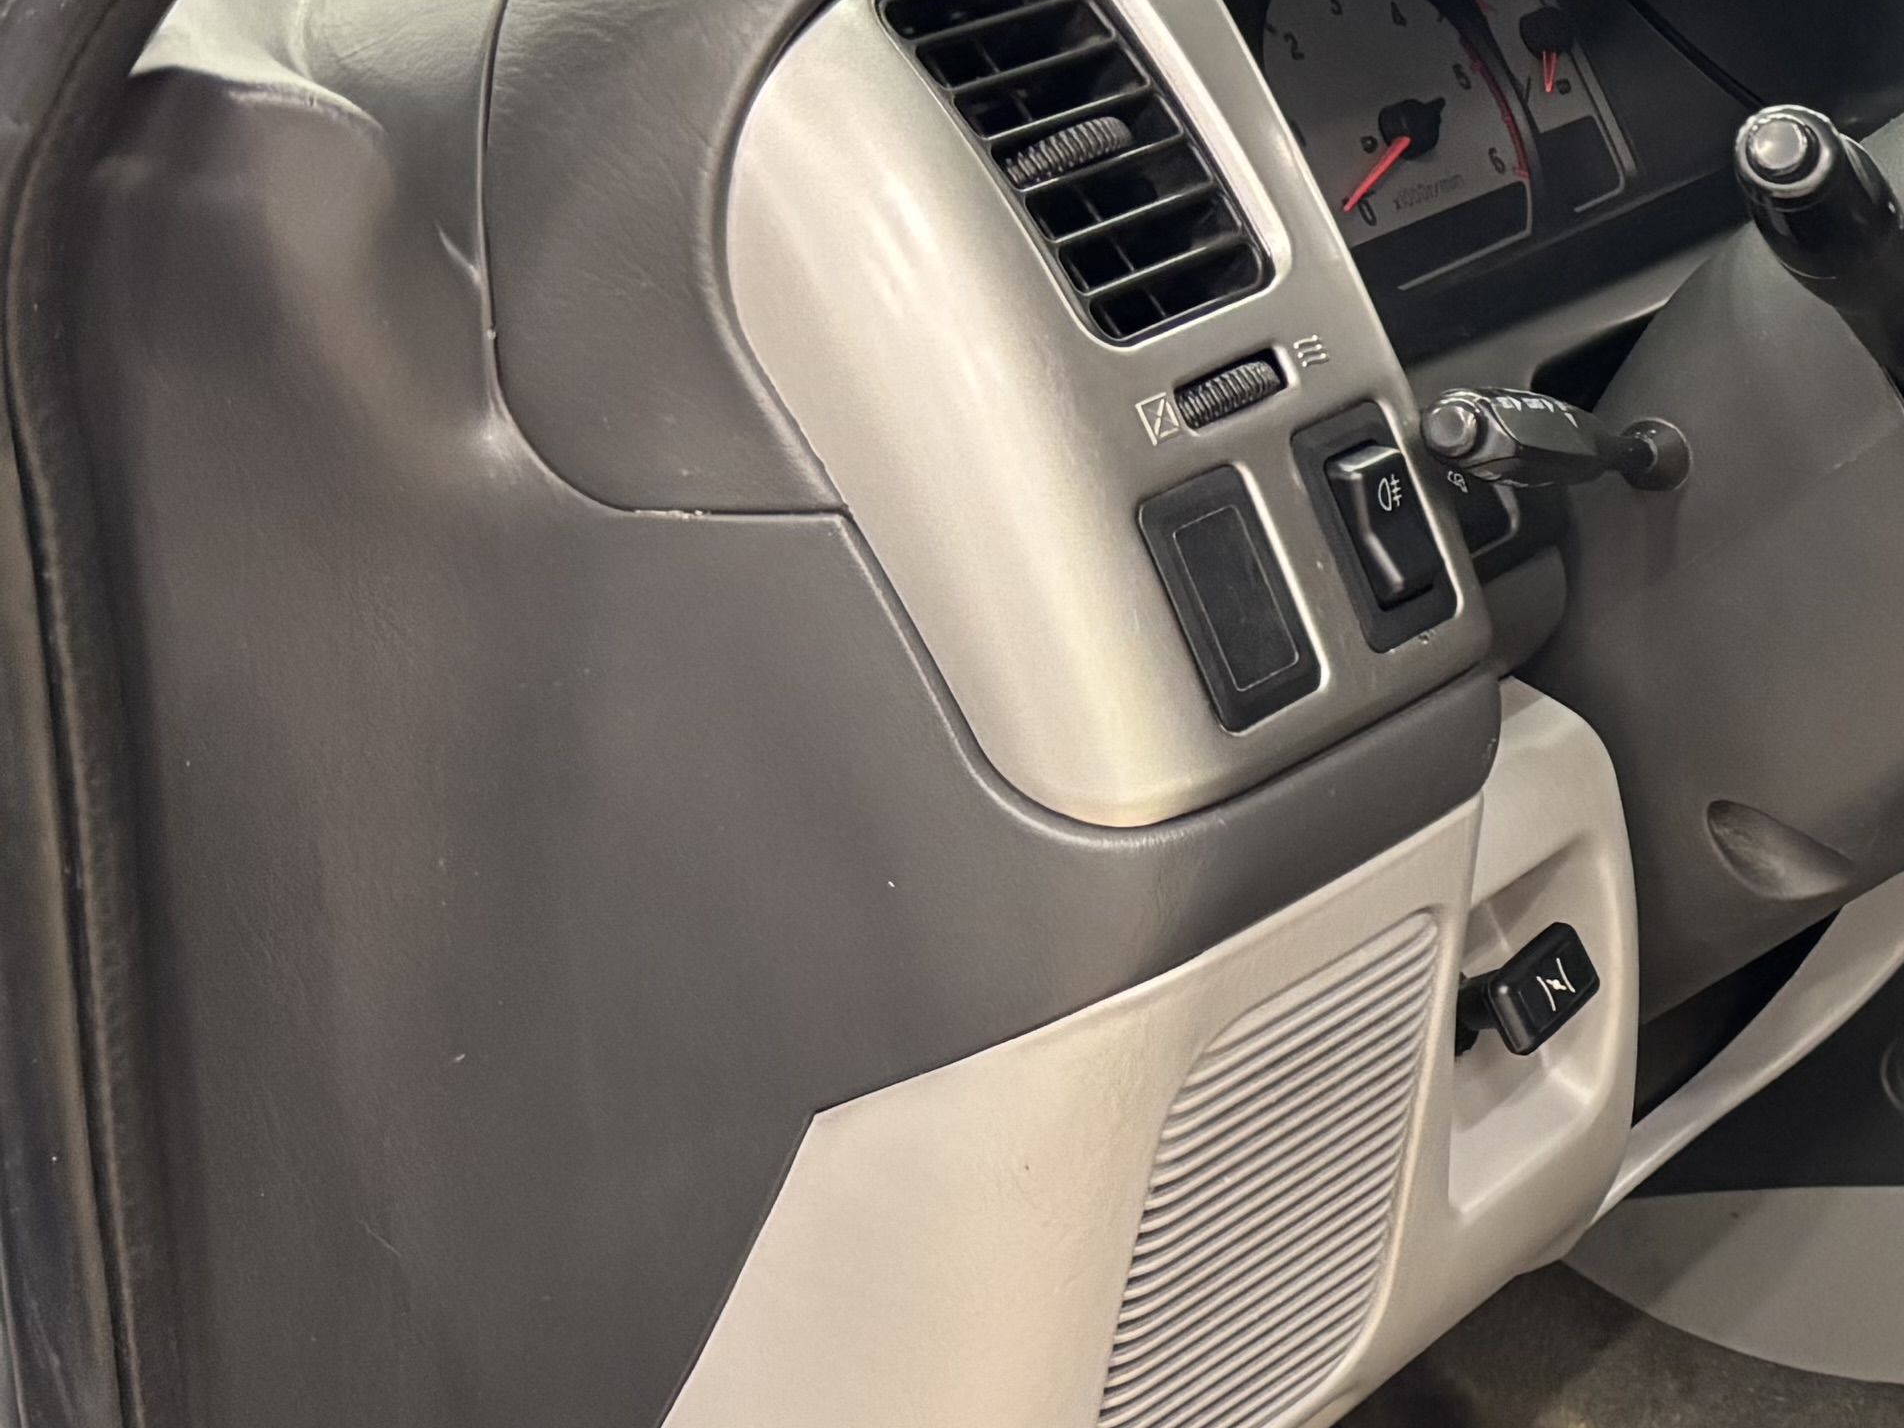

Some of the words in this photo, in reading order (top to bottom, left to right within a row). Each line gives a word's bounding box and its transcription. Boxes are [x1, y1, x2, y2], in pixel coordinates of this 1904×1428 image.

[1391, 1, 1407, 27] 4
[1284, 32, 1305, 61] 2
[1452, 63, 1472, 91] 5
[1488, 147, 1506, 174] 6
[1357, 197, 1377, 227] 0
